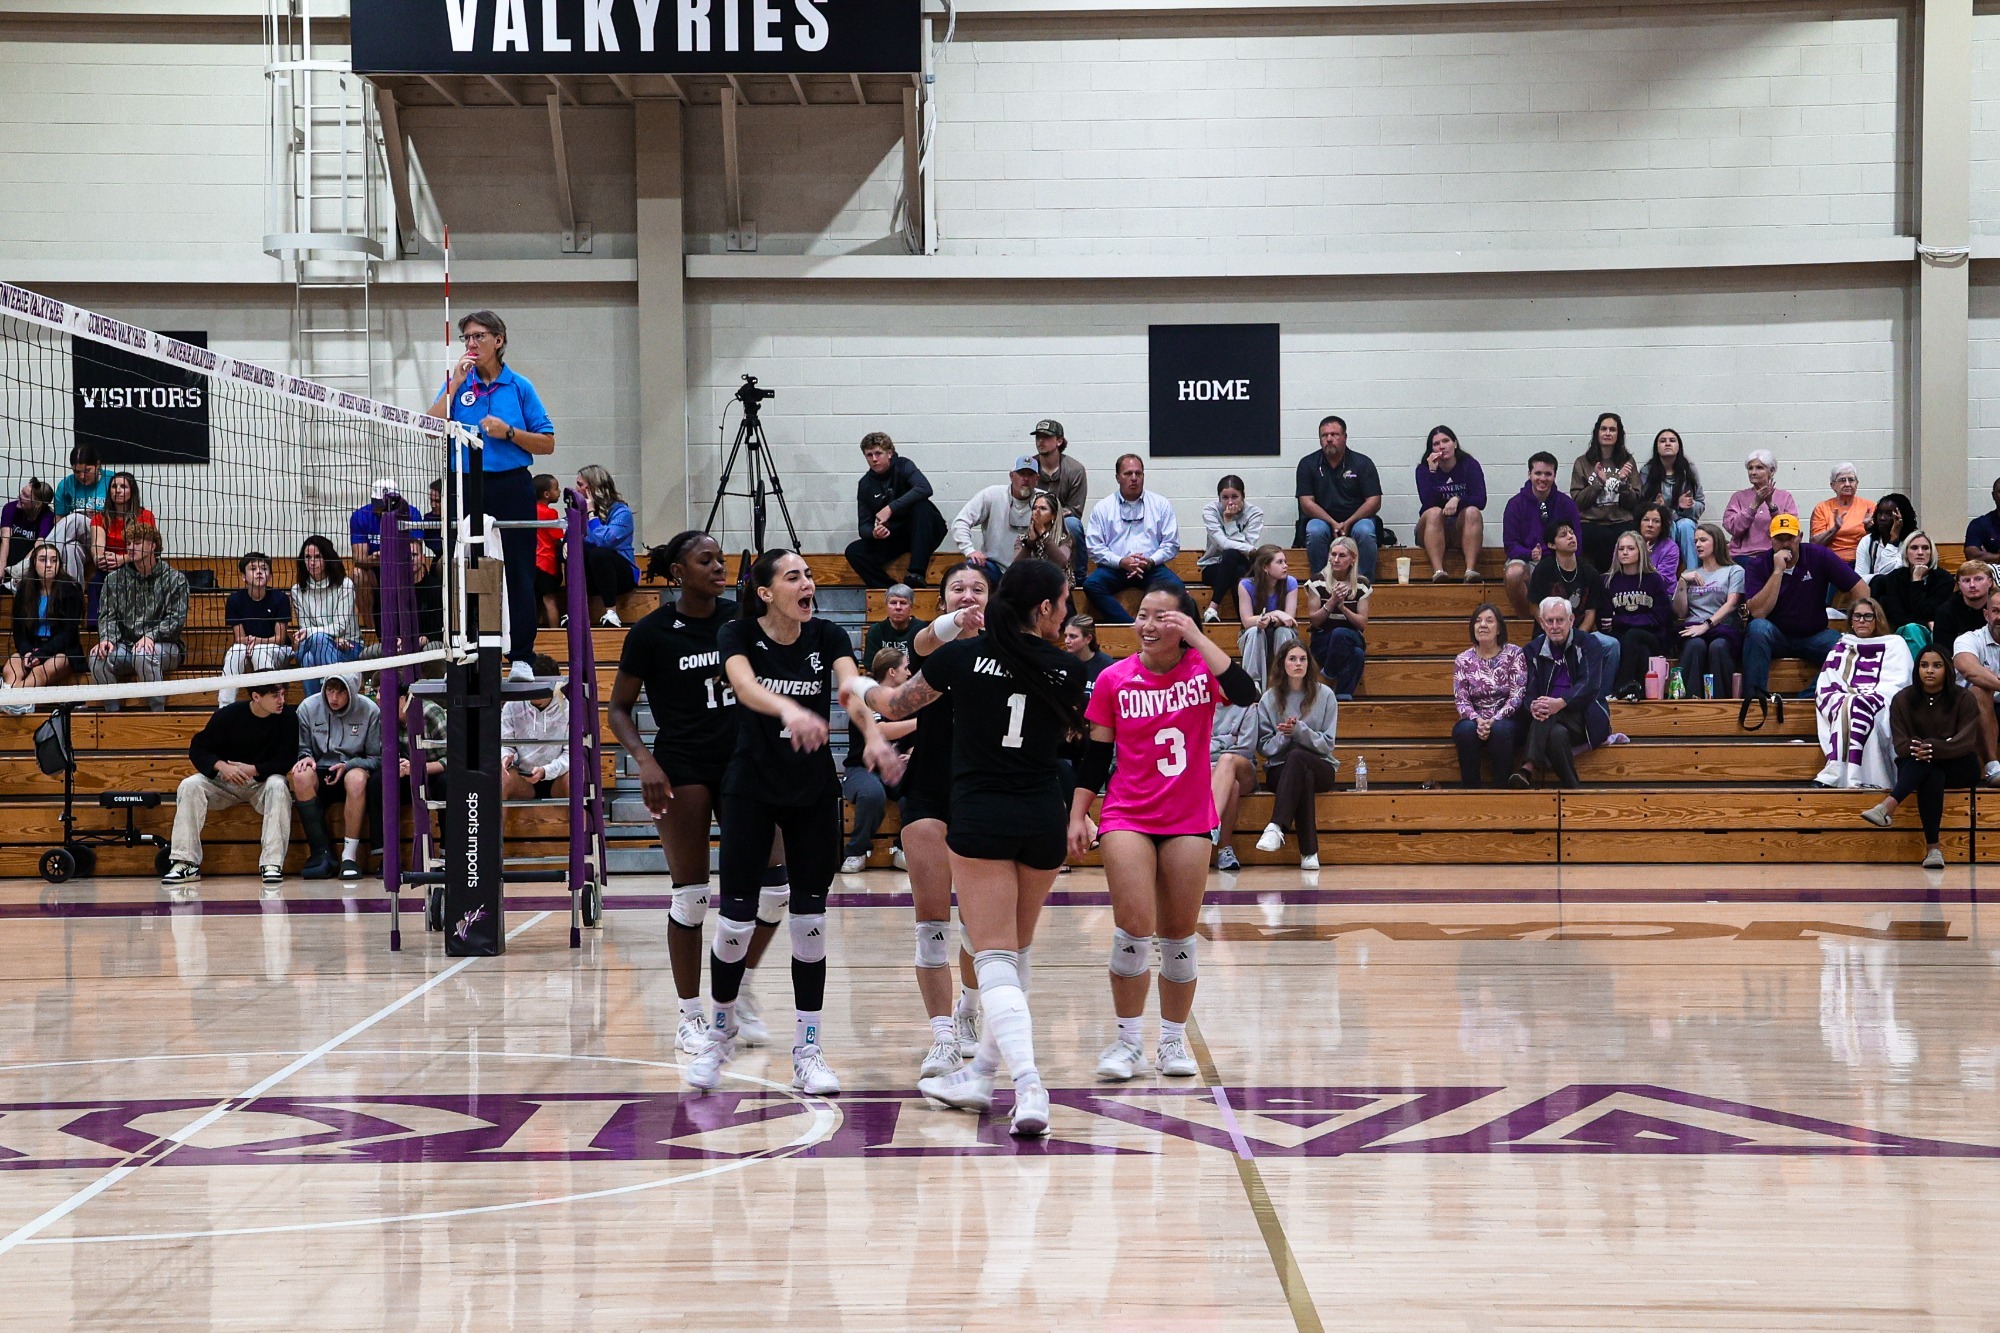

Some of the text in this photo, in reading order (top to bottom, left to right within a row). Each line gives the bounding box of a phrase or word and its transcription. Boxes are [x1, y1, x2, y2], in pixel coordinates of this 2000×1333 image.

[446, 0, 830, 53] VALKYRIES
[79, 387, 203, 409] VISITORS
[1178, 379, 1250, 401] HOME
[1780, 519, 1790, 527] E
[1001, 693, 1027, 748] 1
[1118, 673, 1211, 719] CONVERSE
[1154, 726, 1188, 778] 3
[465, 792, 480, 888] sports imports
